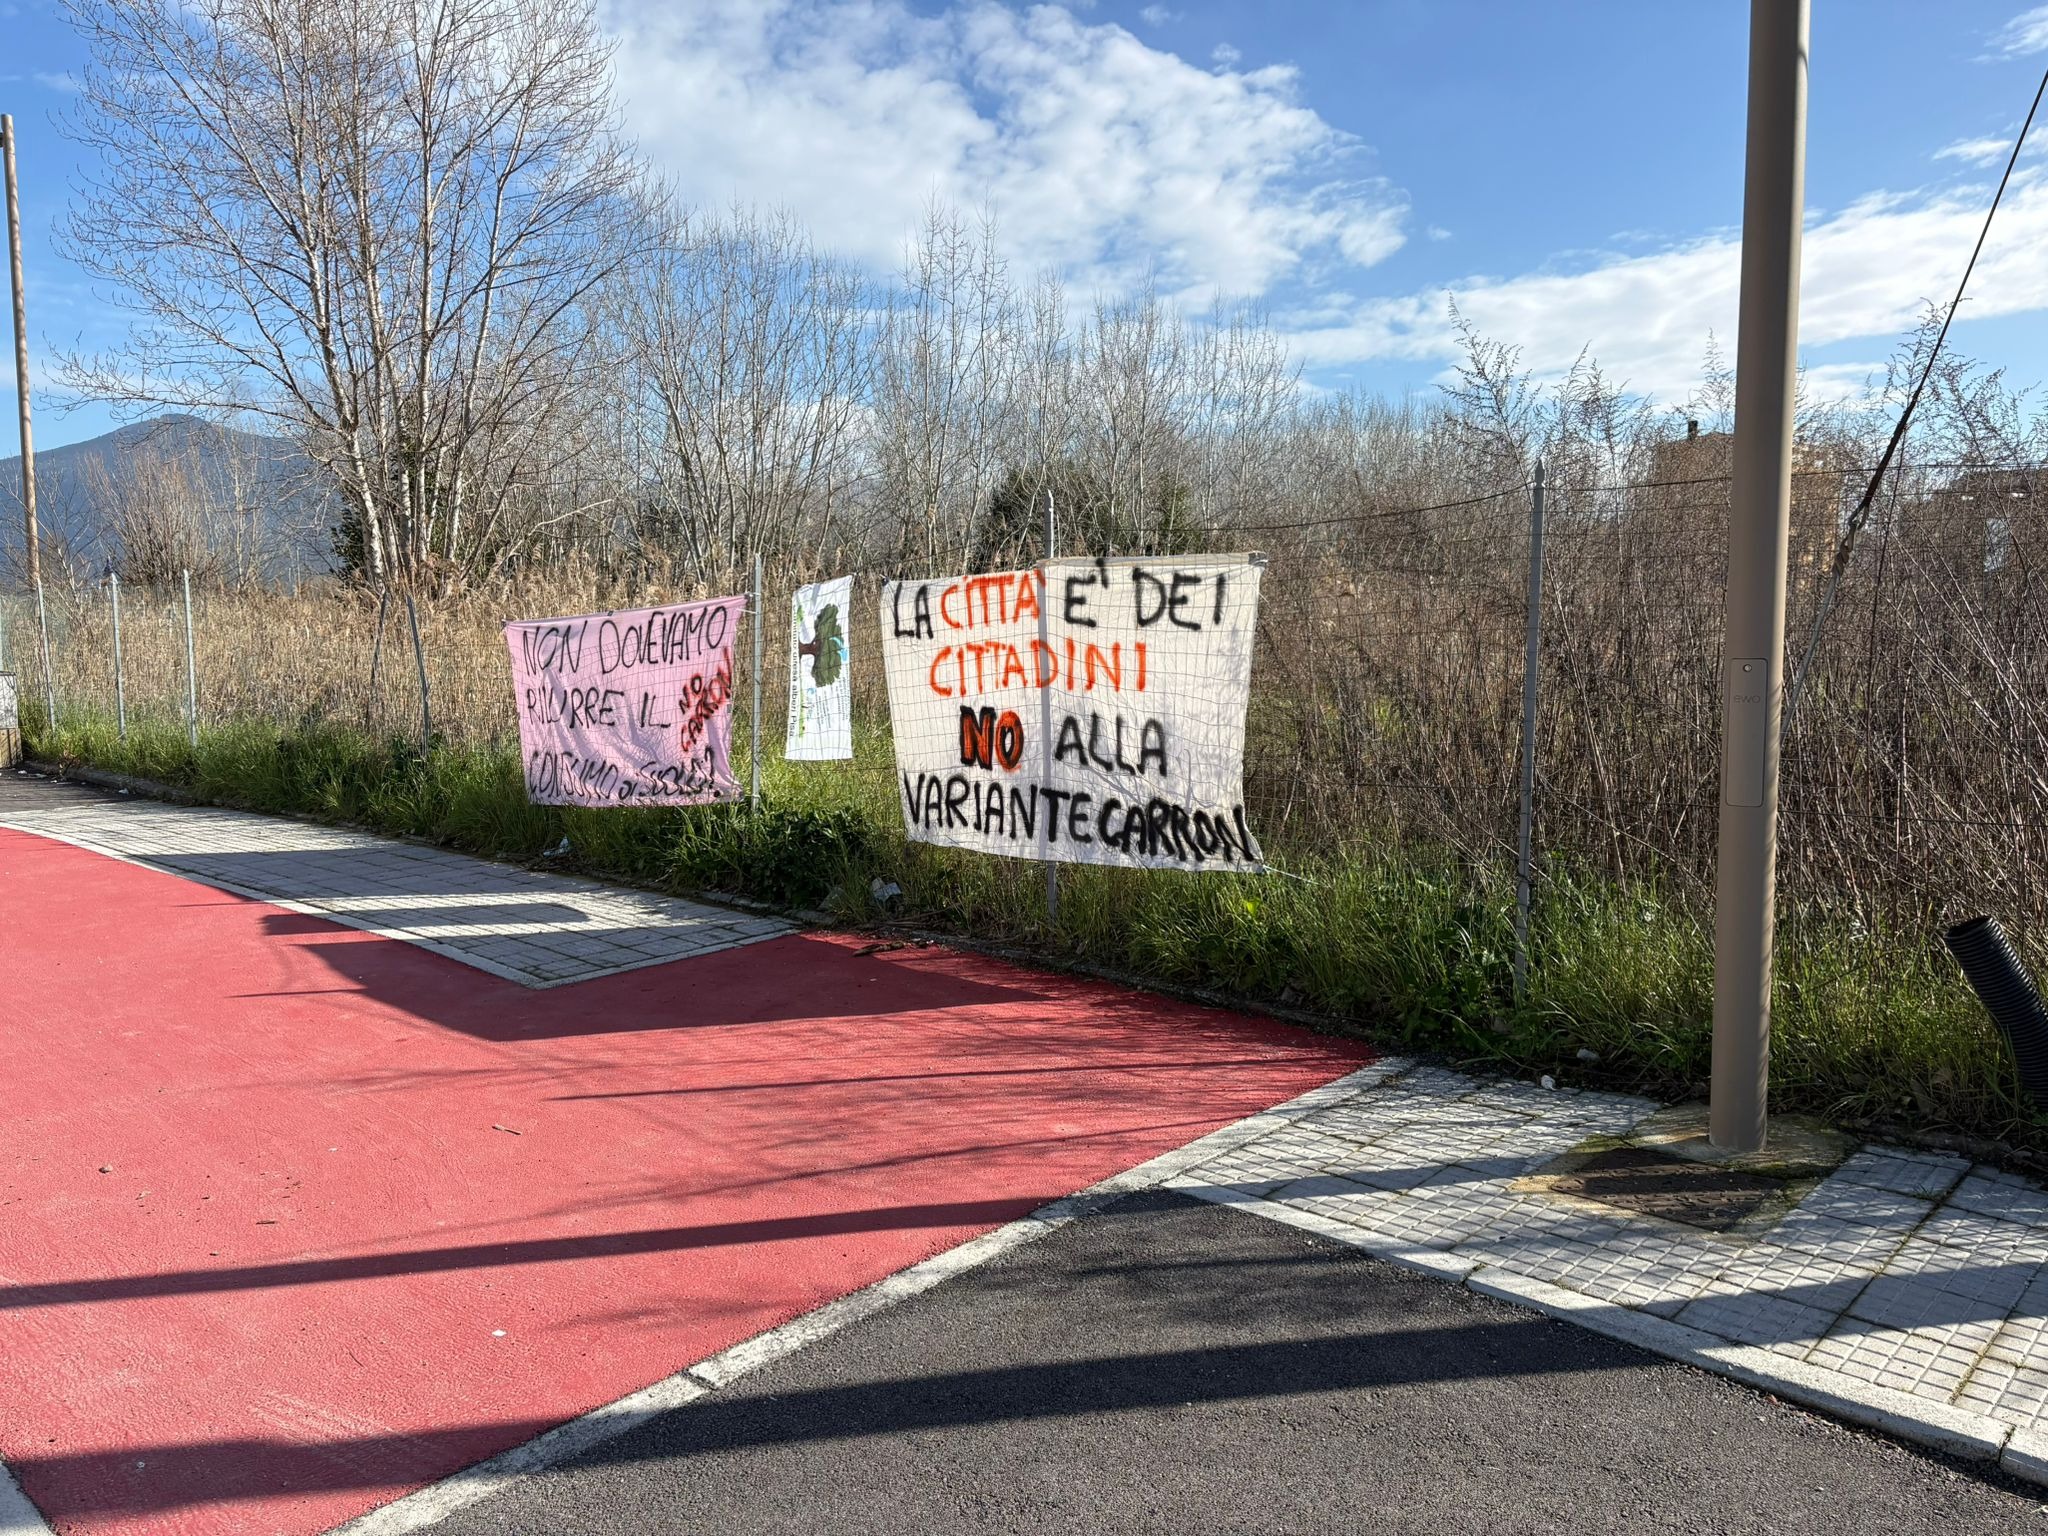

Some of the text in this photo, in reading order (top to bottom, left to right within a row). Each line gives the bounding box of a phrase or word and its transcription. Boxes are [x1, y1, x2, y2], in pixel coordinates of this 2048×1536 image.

[894, 581, 934, 639] LA
[1132, 567, 1225, 631] DEI
[523, 606, 728, 676] NON DOVEVAMO
[930, 637, 1147, 698] CITTADINI
[640, 692, 671, 728] IL
[679, 671, 703, 715] NO
[789, 715, 797, 737] Pisa
[959, 704, 1168, 777] NO ALLA
[904, 772, 1254, 863] VARIANTE CARRON
